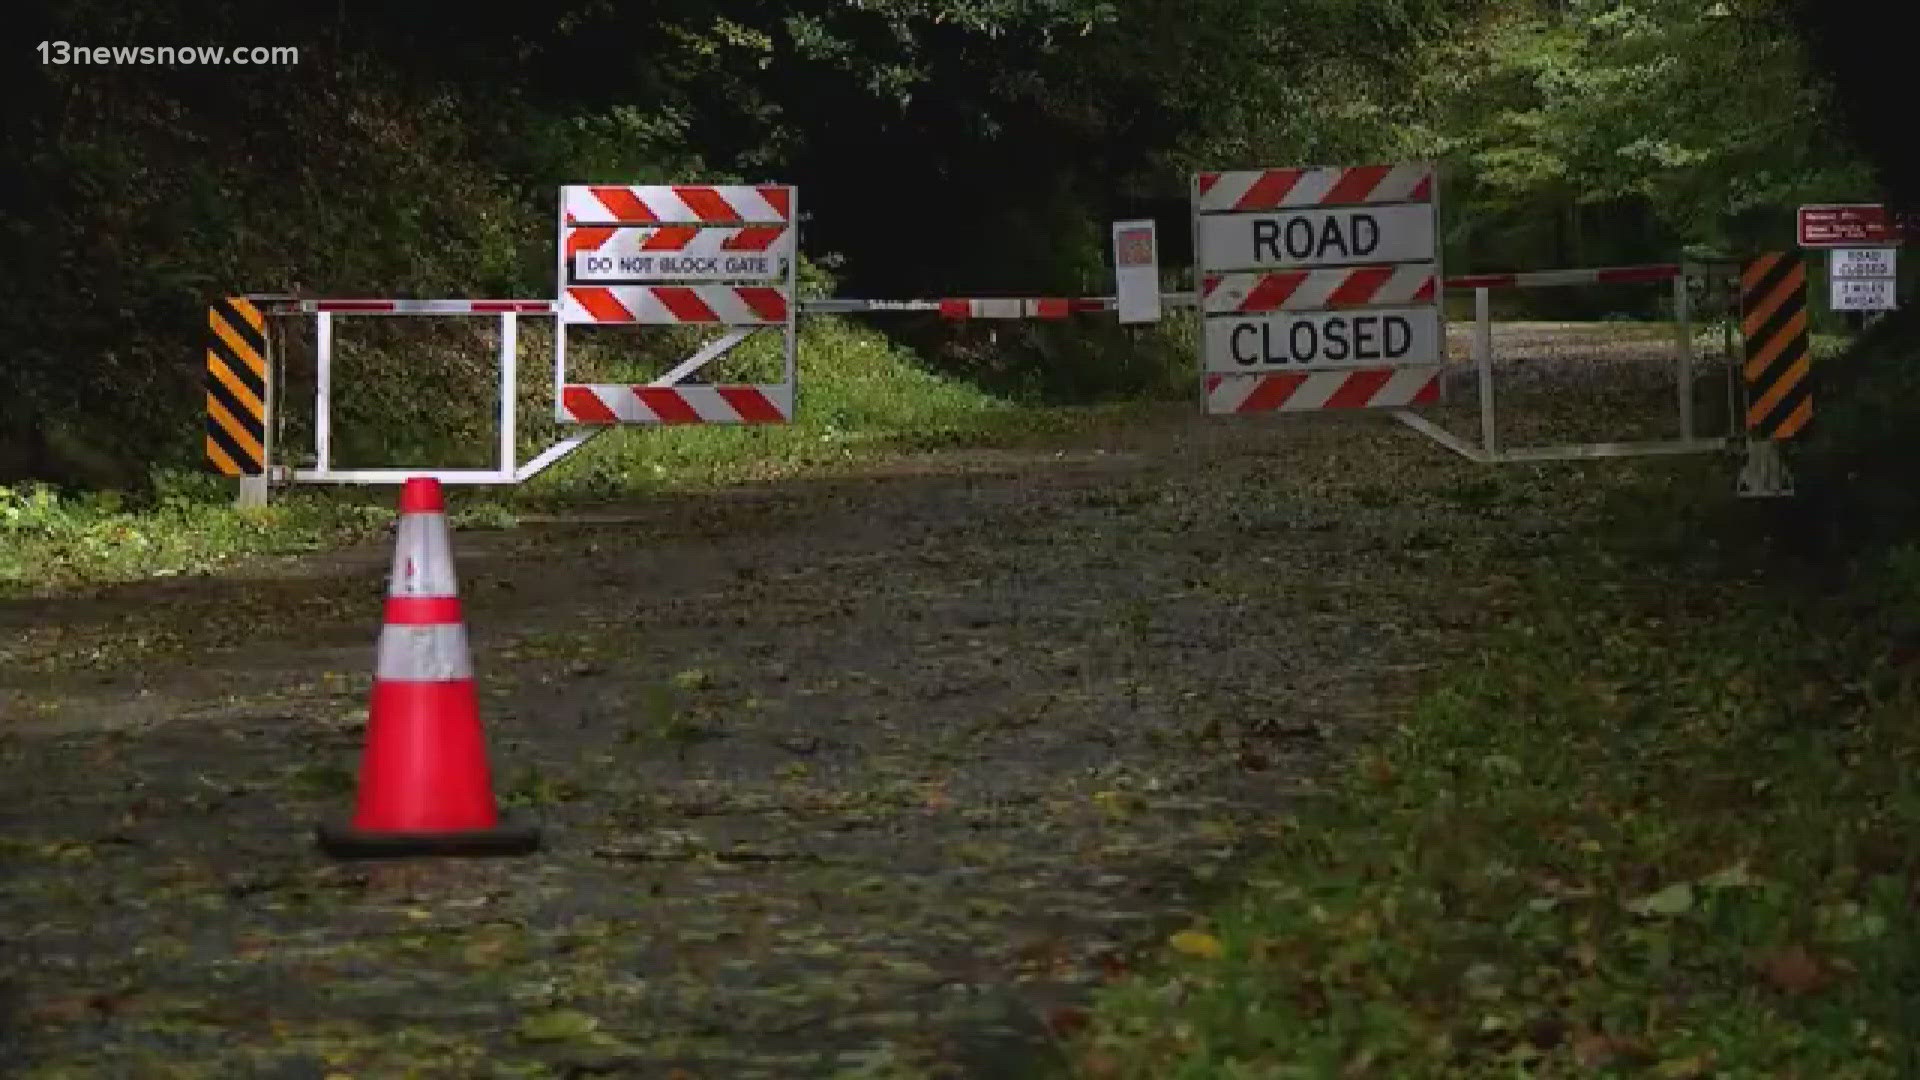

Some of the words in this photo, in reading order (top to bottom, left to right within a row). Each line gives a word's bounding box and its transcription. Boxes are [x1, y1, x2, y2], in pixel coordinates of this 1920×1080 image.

[1253, 214, 1380, 262] ROAD
[587, 257, 612, 273] DO
[620, 257, 652, 273] NOT
[660, 257, 717, 273] BLOCK
[726, 257, 768, 273] GATE
[1230, 317, 1413, 366] CLOSED
